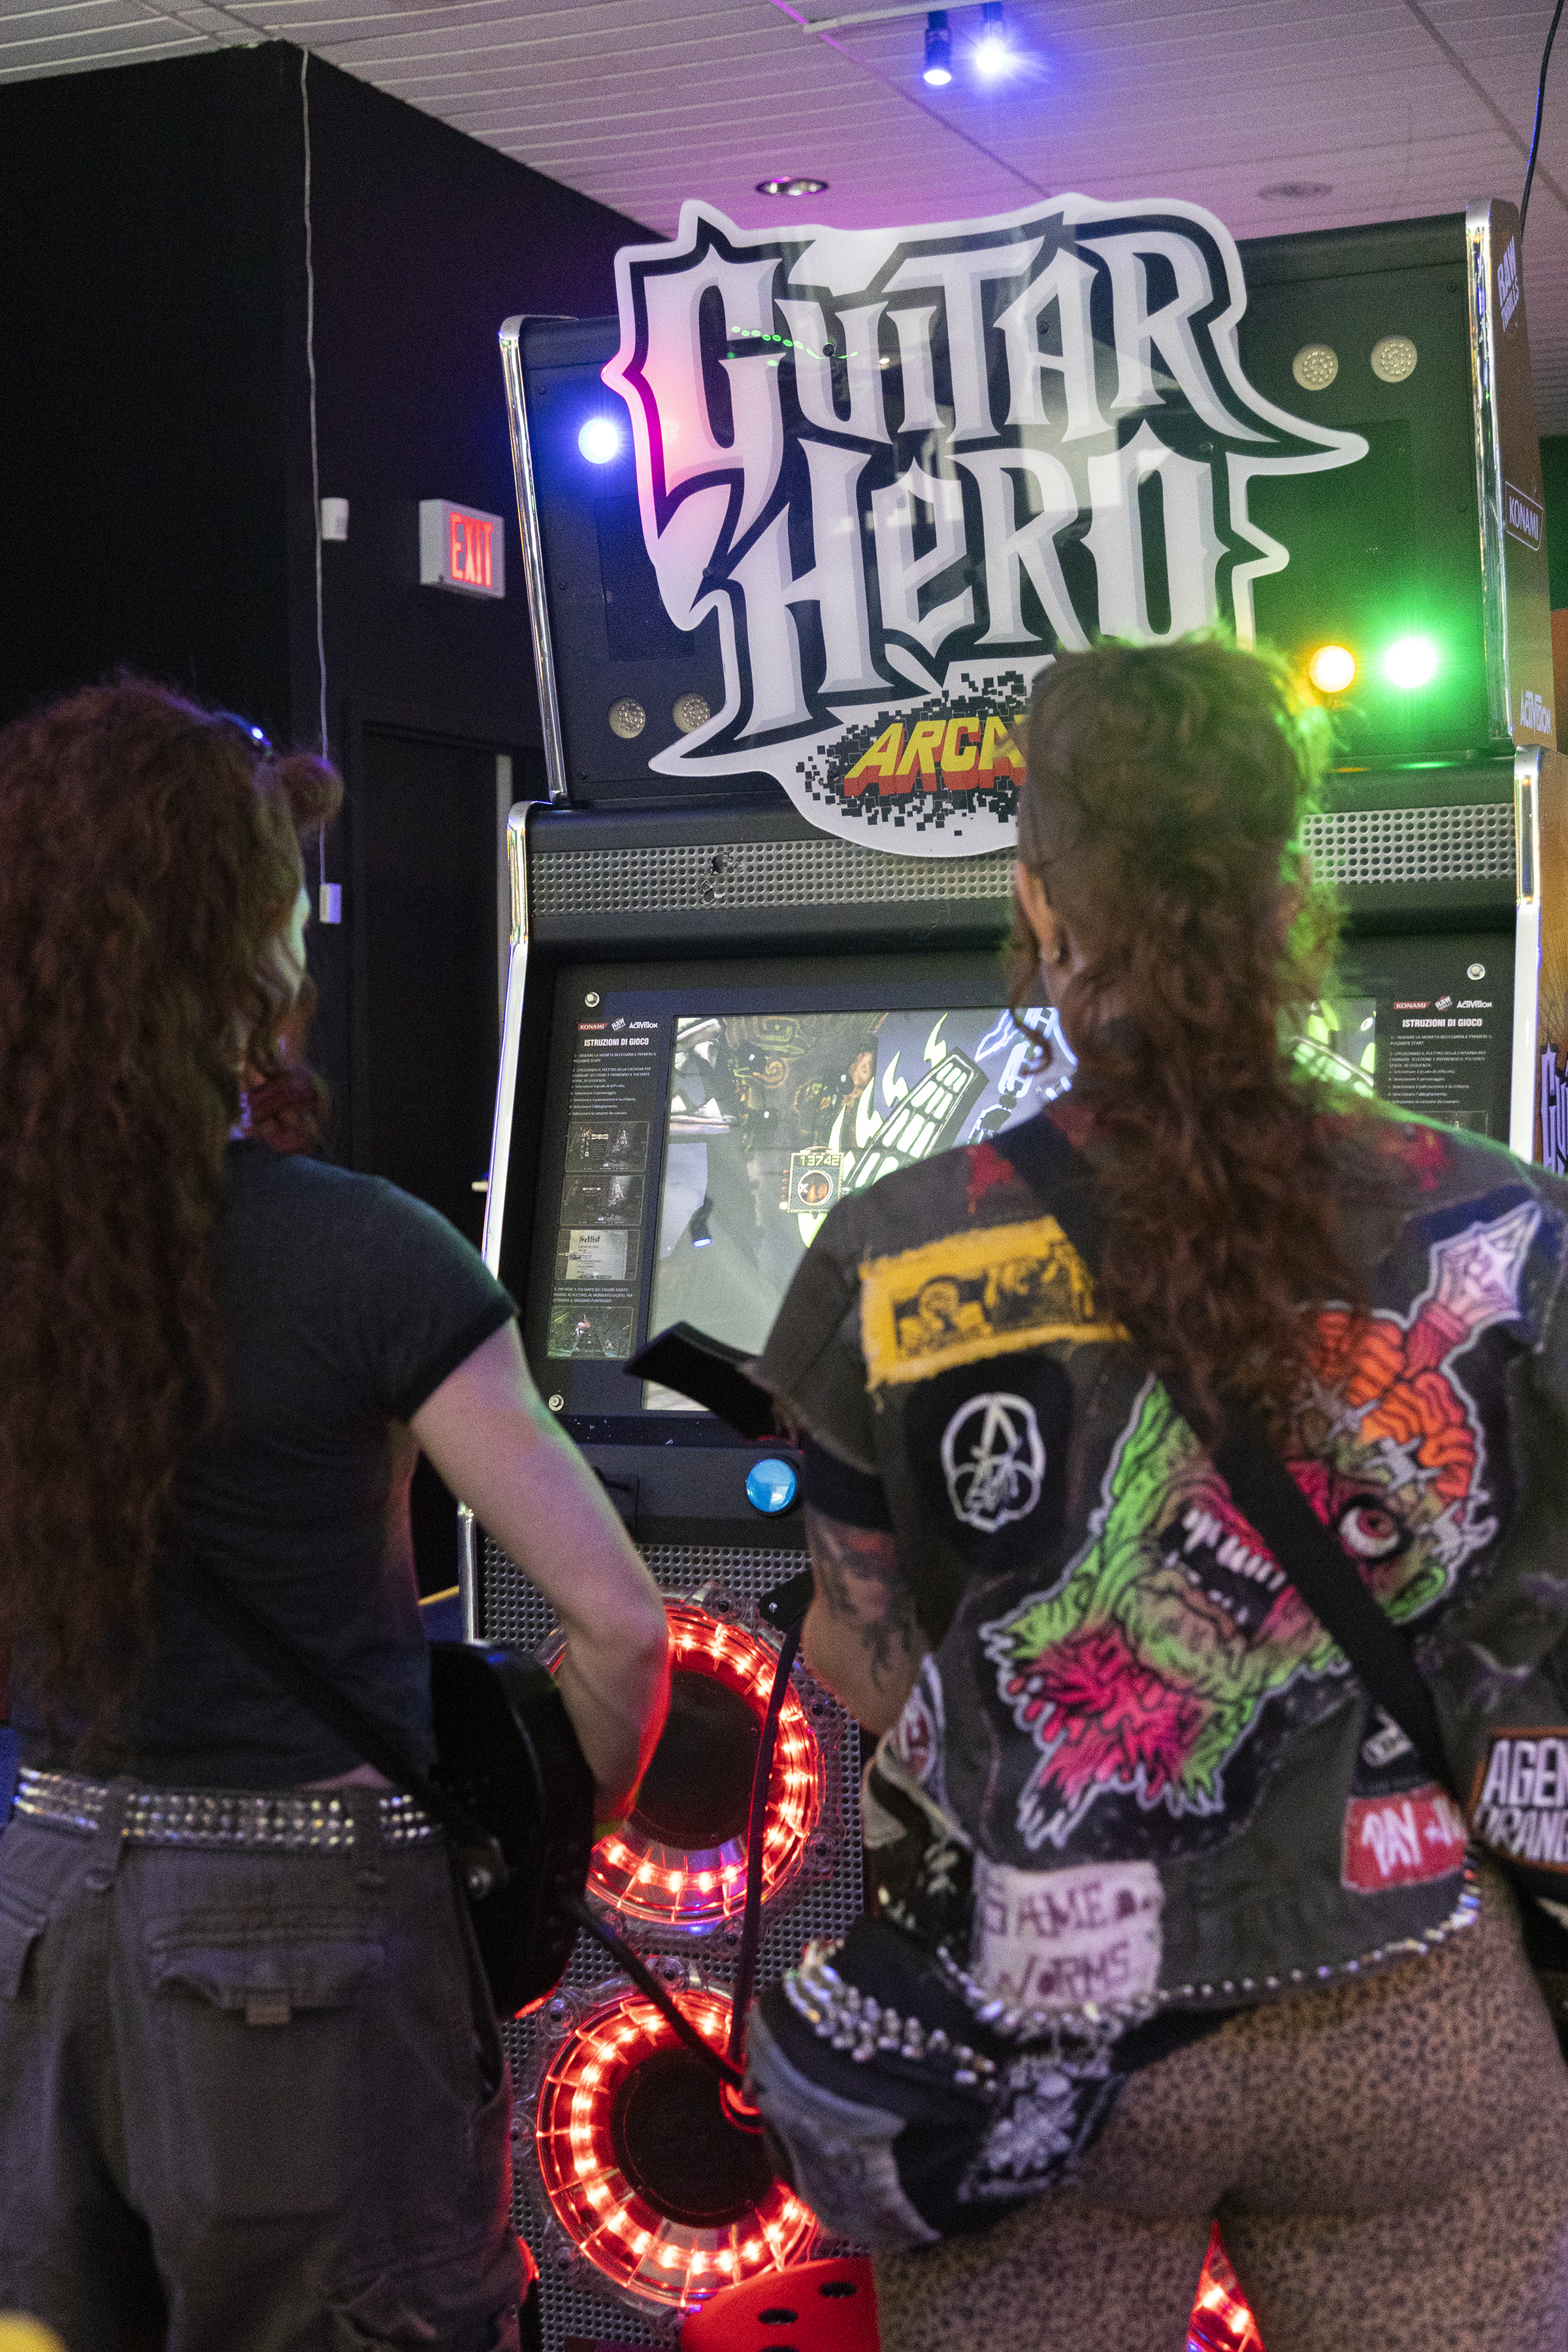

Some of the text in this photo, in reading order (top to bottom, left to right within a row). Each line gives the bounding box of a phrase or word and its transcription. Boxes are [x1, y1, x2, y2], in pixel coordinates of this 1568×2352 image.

[1497, 235, 1516, 308] RAW
[641, 231, 1282, 555] GUITAR
[1509, 496, 1539, 540] KONAMI
[449, 512, 494, 589] EXIT
[727, 420, 1231, 741] HERO
[1520, 689, 1551, 734] ACTIVISION
[843, 714, 1032, 796] ARCA
[612, 1017, 625, 1028] RAW
[1402, 1018, 1482, 1027] ISTRUZIONI DI GIOCO
[1435, 996, 1450, 1008] RAW
[584, 1038, 619, 1047] ISTRUZIONI
[800, 1154, 840, 1167] 13742
[578, 1234, 600, 1243] Setlist
